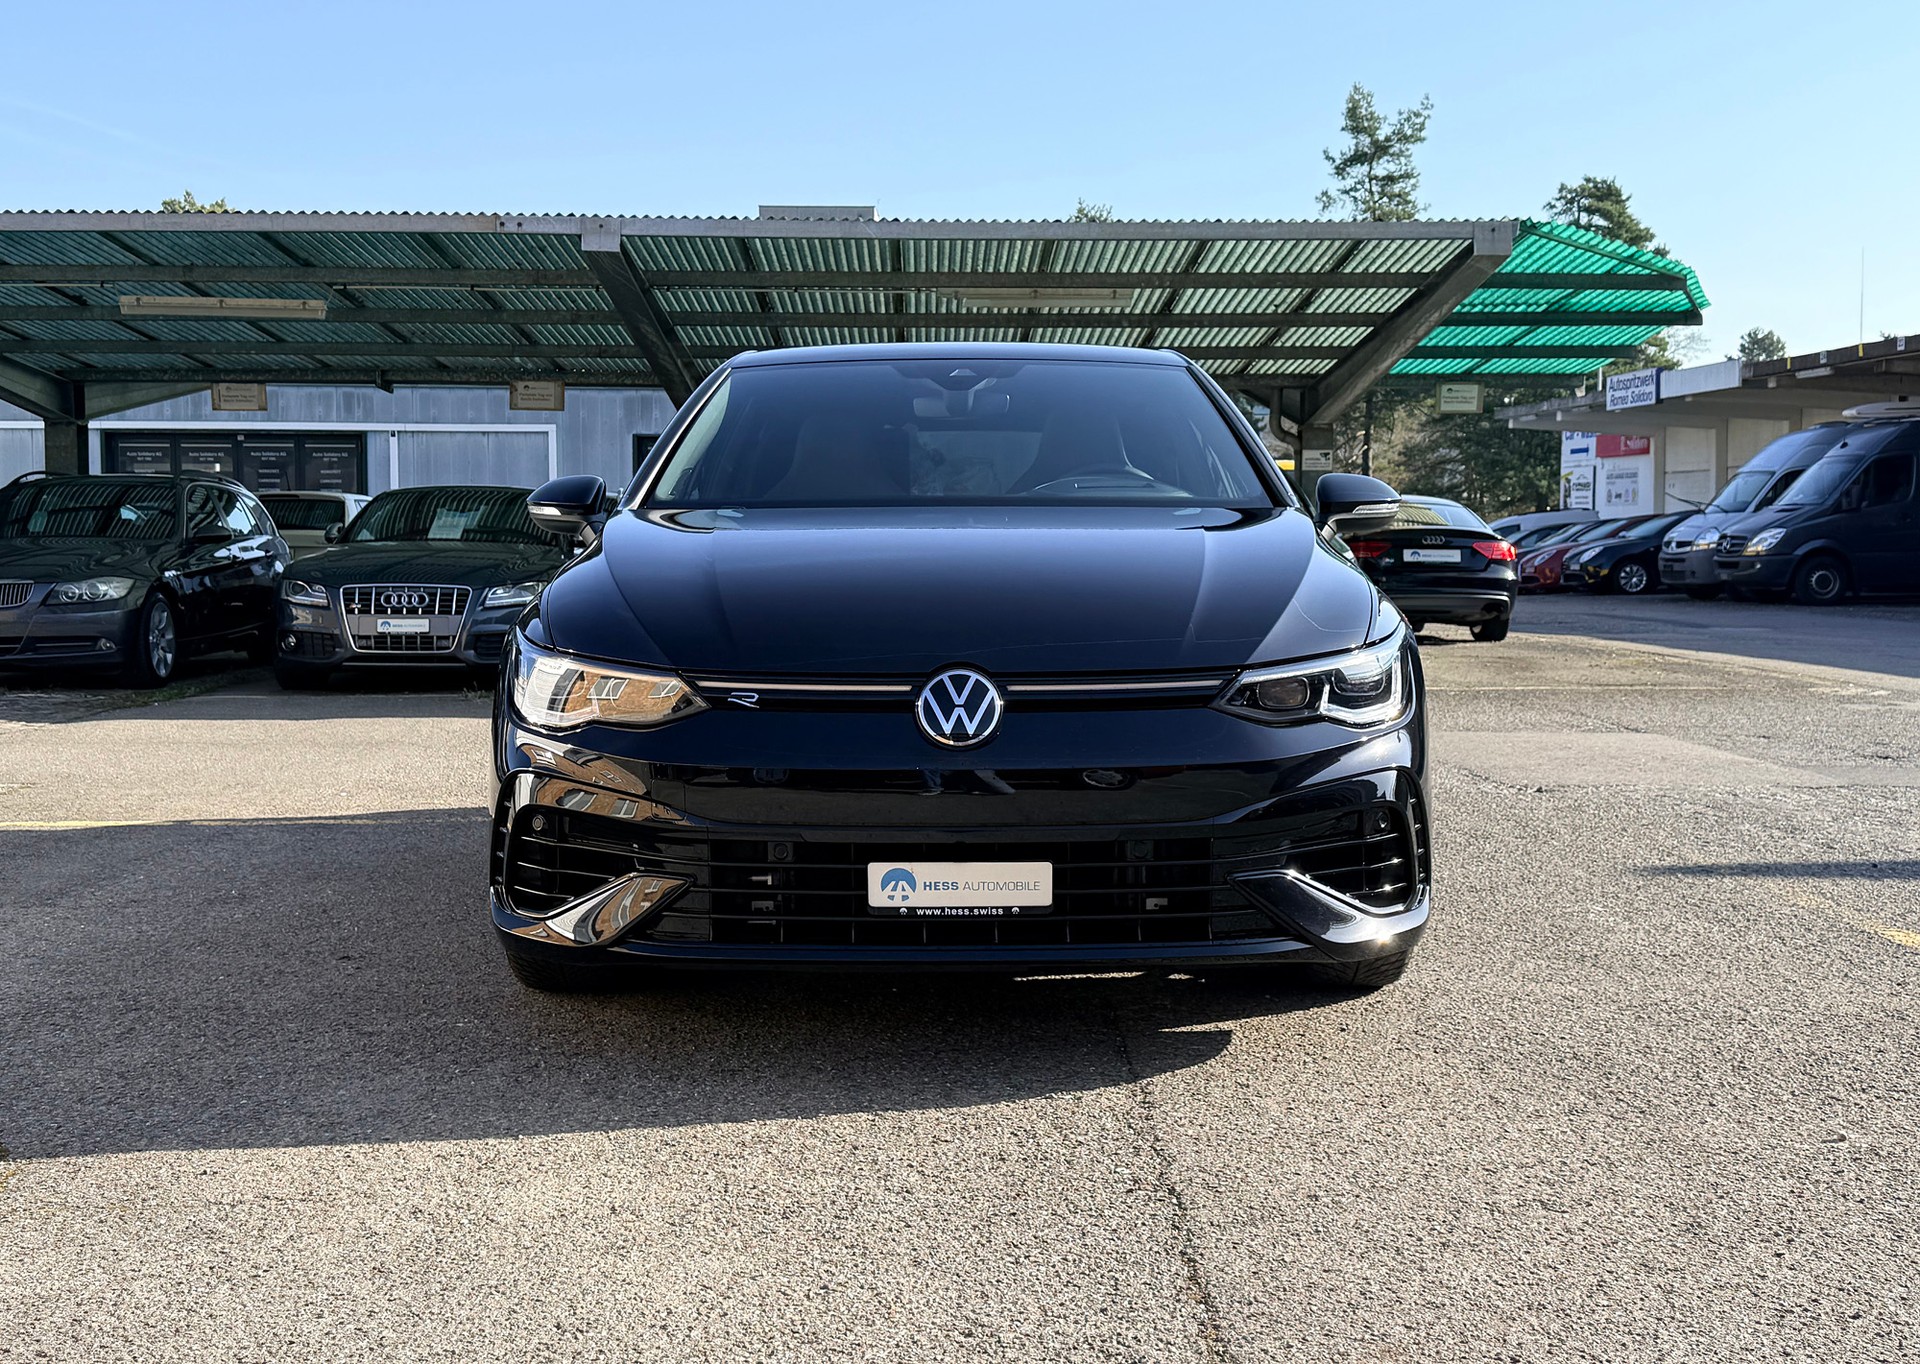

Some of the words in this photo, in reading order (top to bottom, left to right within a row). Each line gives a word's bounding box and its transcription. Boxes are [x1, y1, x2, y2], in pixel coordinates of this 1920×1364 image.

[1608, 370, 1655, 393] Autospritzwerk
[1609, 393, 1629, 407] Romeo
[1630, 389, 1654, 404] Solidoro
[923, 881, 959, 891] HESS
[962, 881, 1041, 891] AUTOMOBILE
[915, 907, 1004, 916] www.hess.swiss
